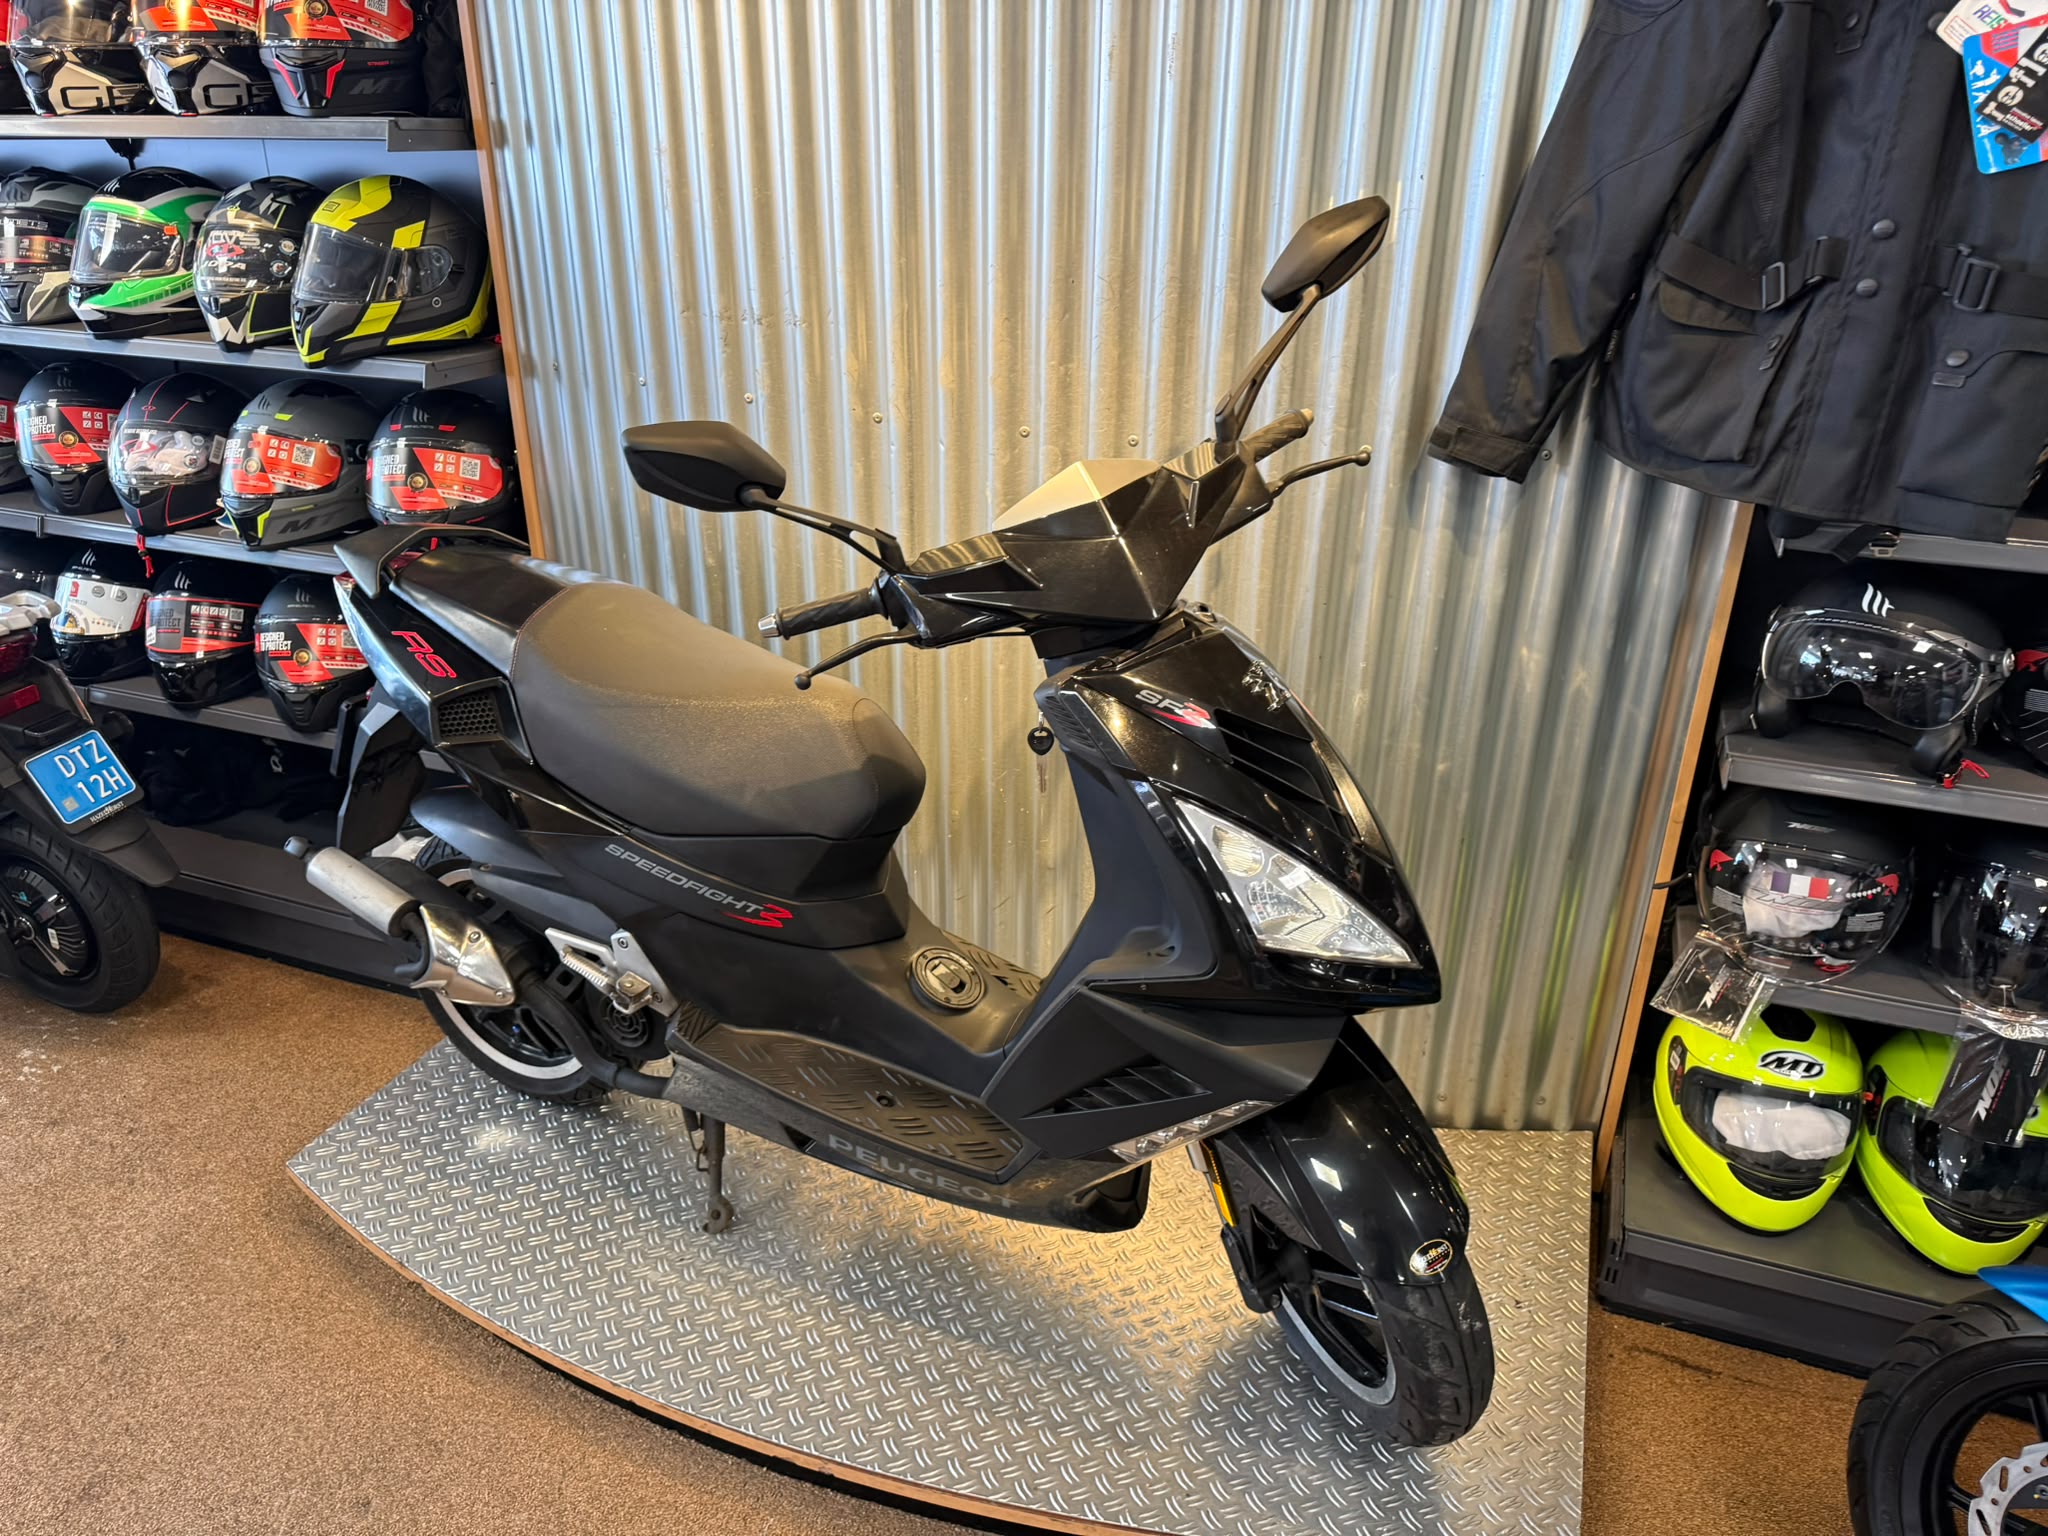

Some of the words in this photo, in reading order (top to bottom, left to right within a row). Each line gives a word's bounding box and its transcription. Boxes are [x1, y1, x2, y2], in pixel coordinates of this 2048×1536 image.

[391, 630, 457, 679] RS
[54, 738, 108, 779] DTZ
[77, 765, 127, 804] 12H
[604, 842, 764, 914] SPEEDFIGHT
[1759, 1056, 1825, 1075] MT
[828, 1134, 1019, 1209] PEUGEOT
